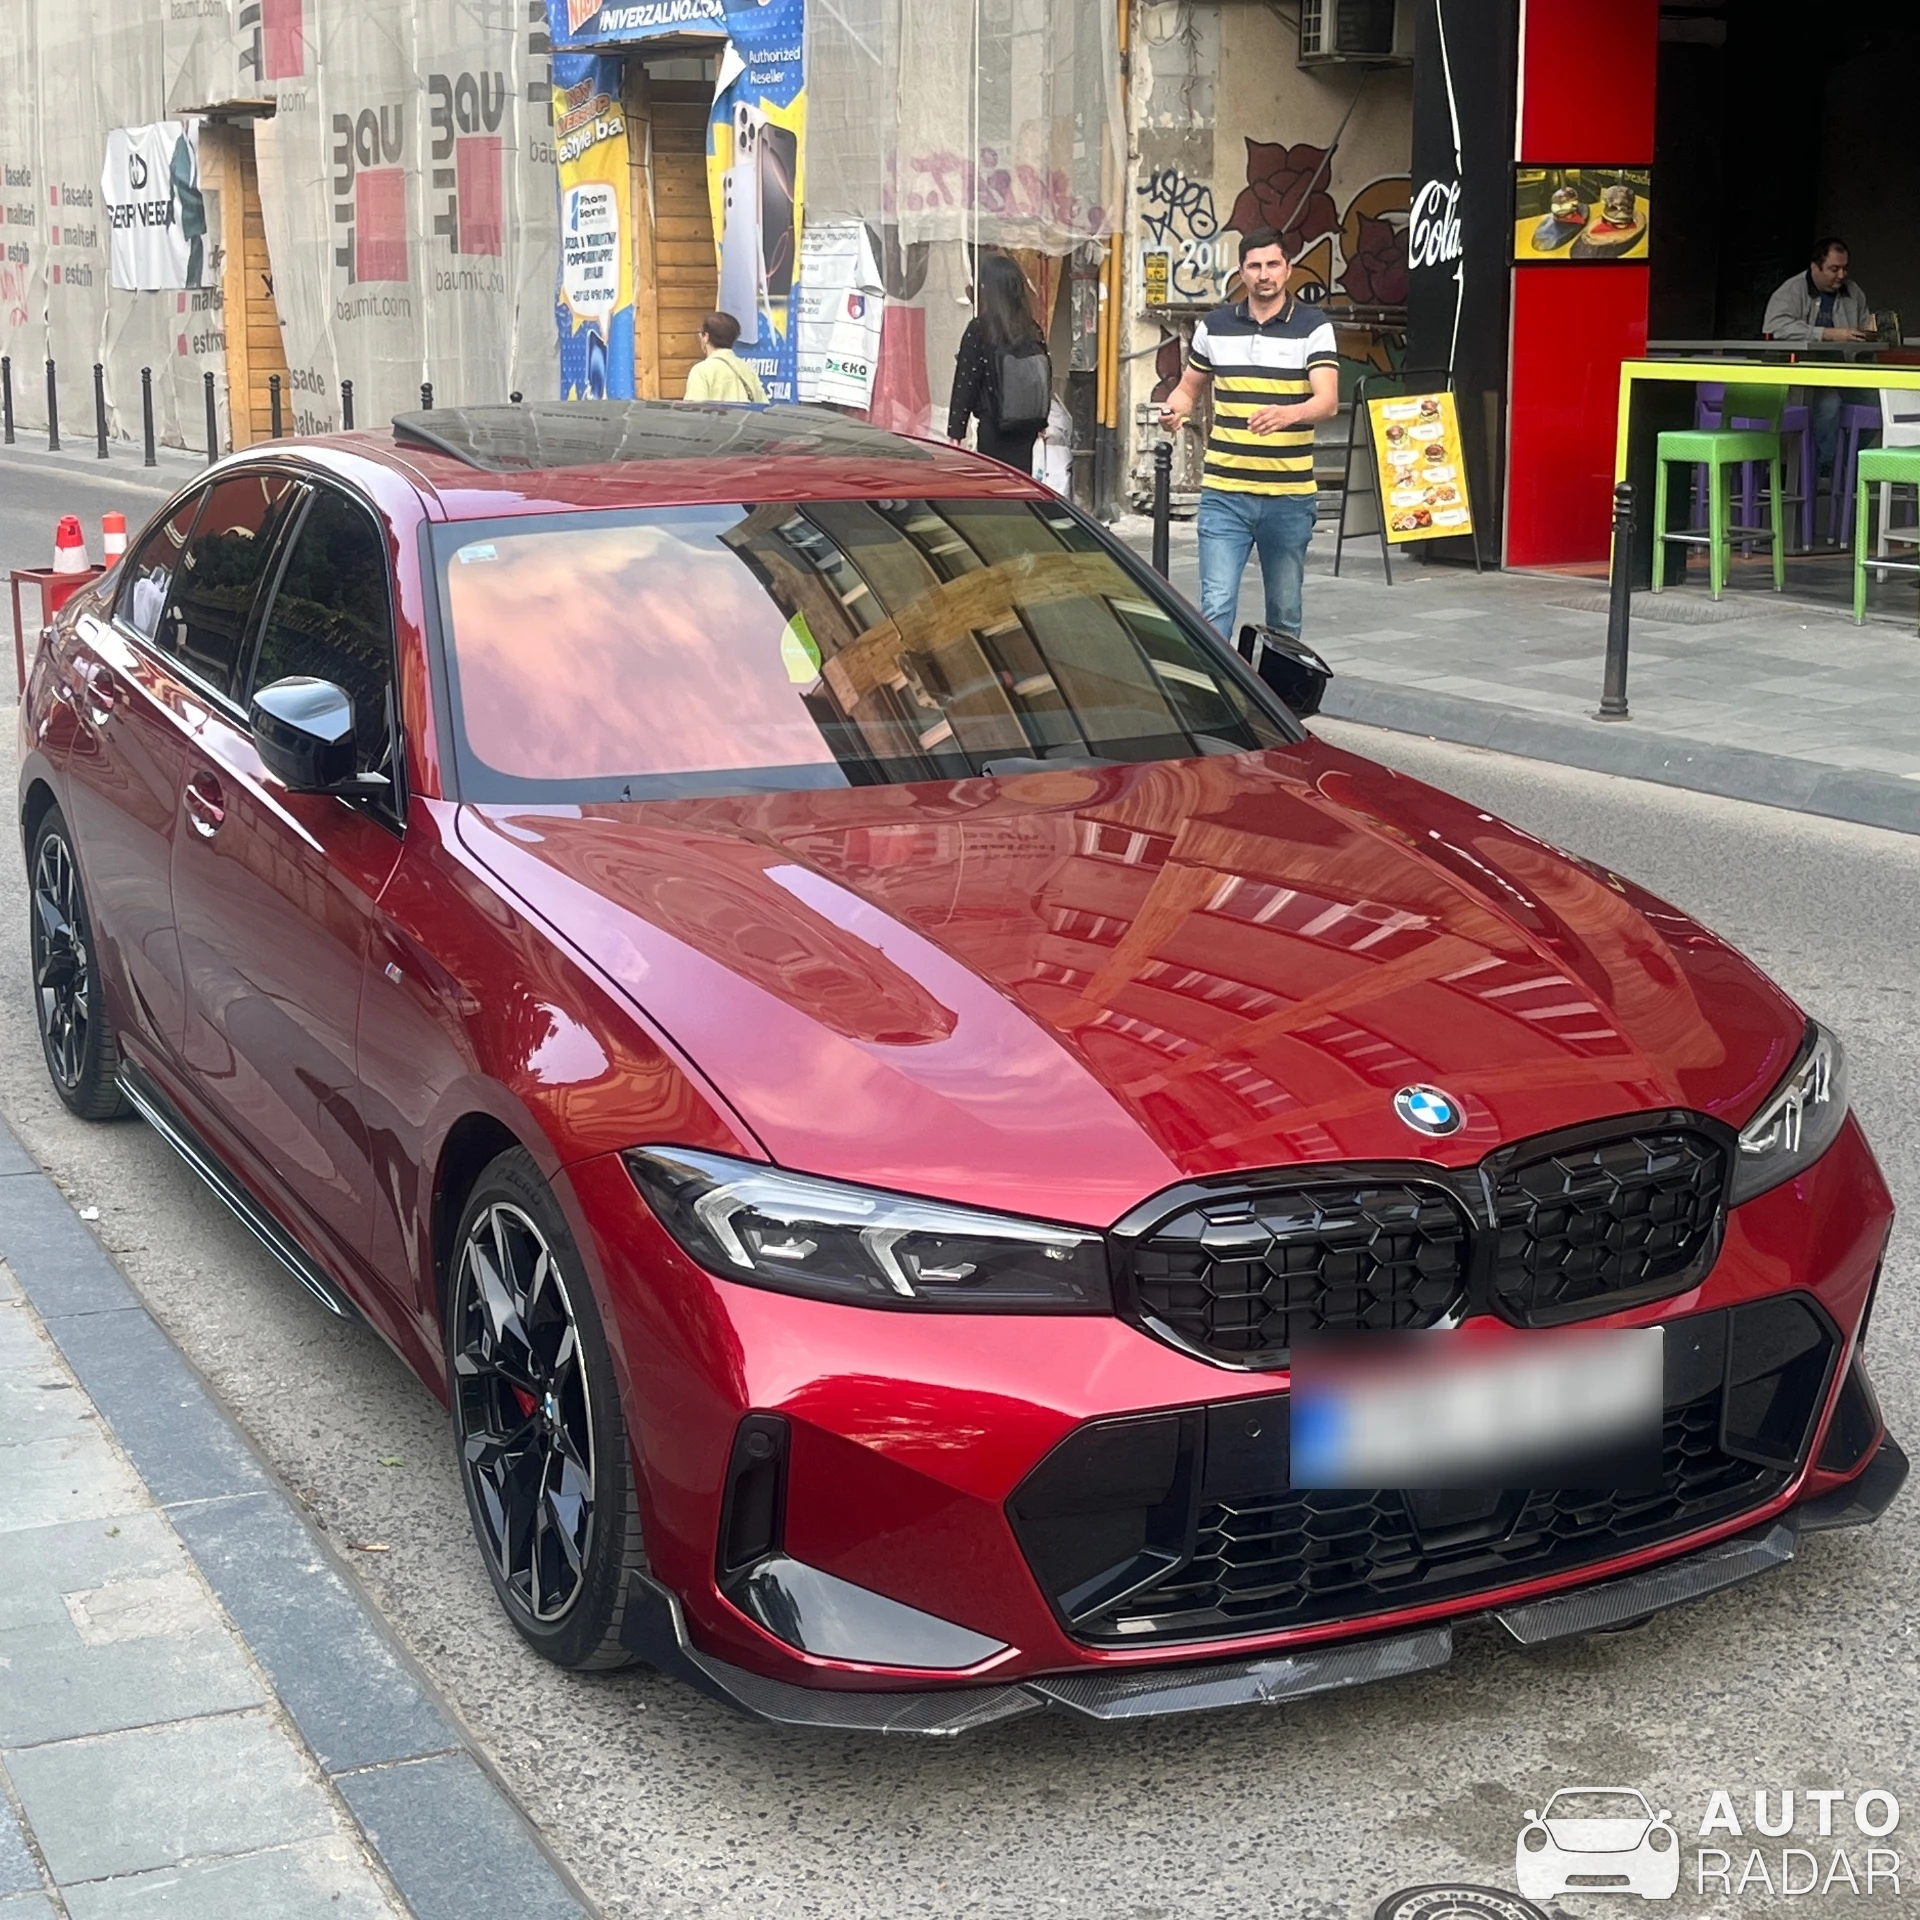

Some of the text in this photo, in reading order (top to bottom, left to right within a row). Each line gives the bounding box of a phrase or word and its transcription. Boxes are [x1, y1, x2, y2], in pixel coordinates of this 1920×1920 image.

[749, 45, 801, 64] Authorized
[750, 68, 785, 84] Reseller
[62, 182, 93, 208] fasade
[64, 224, 97, 248] malteri
[65, 264, 93, 287] estrih
[336, 292, 411, 321] baumit.com
